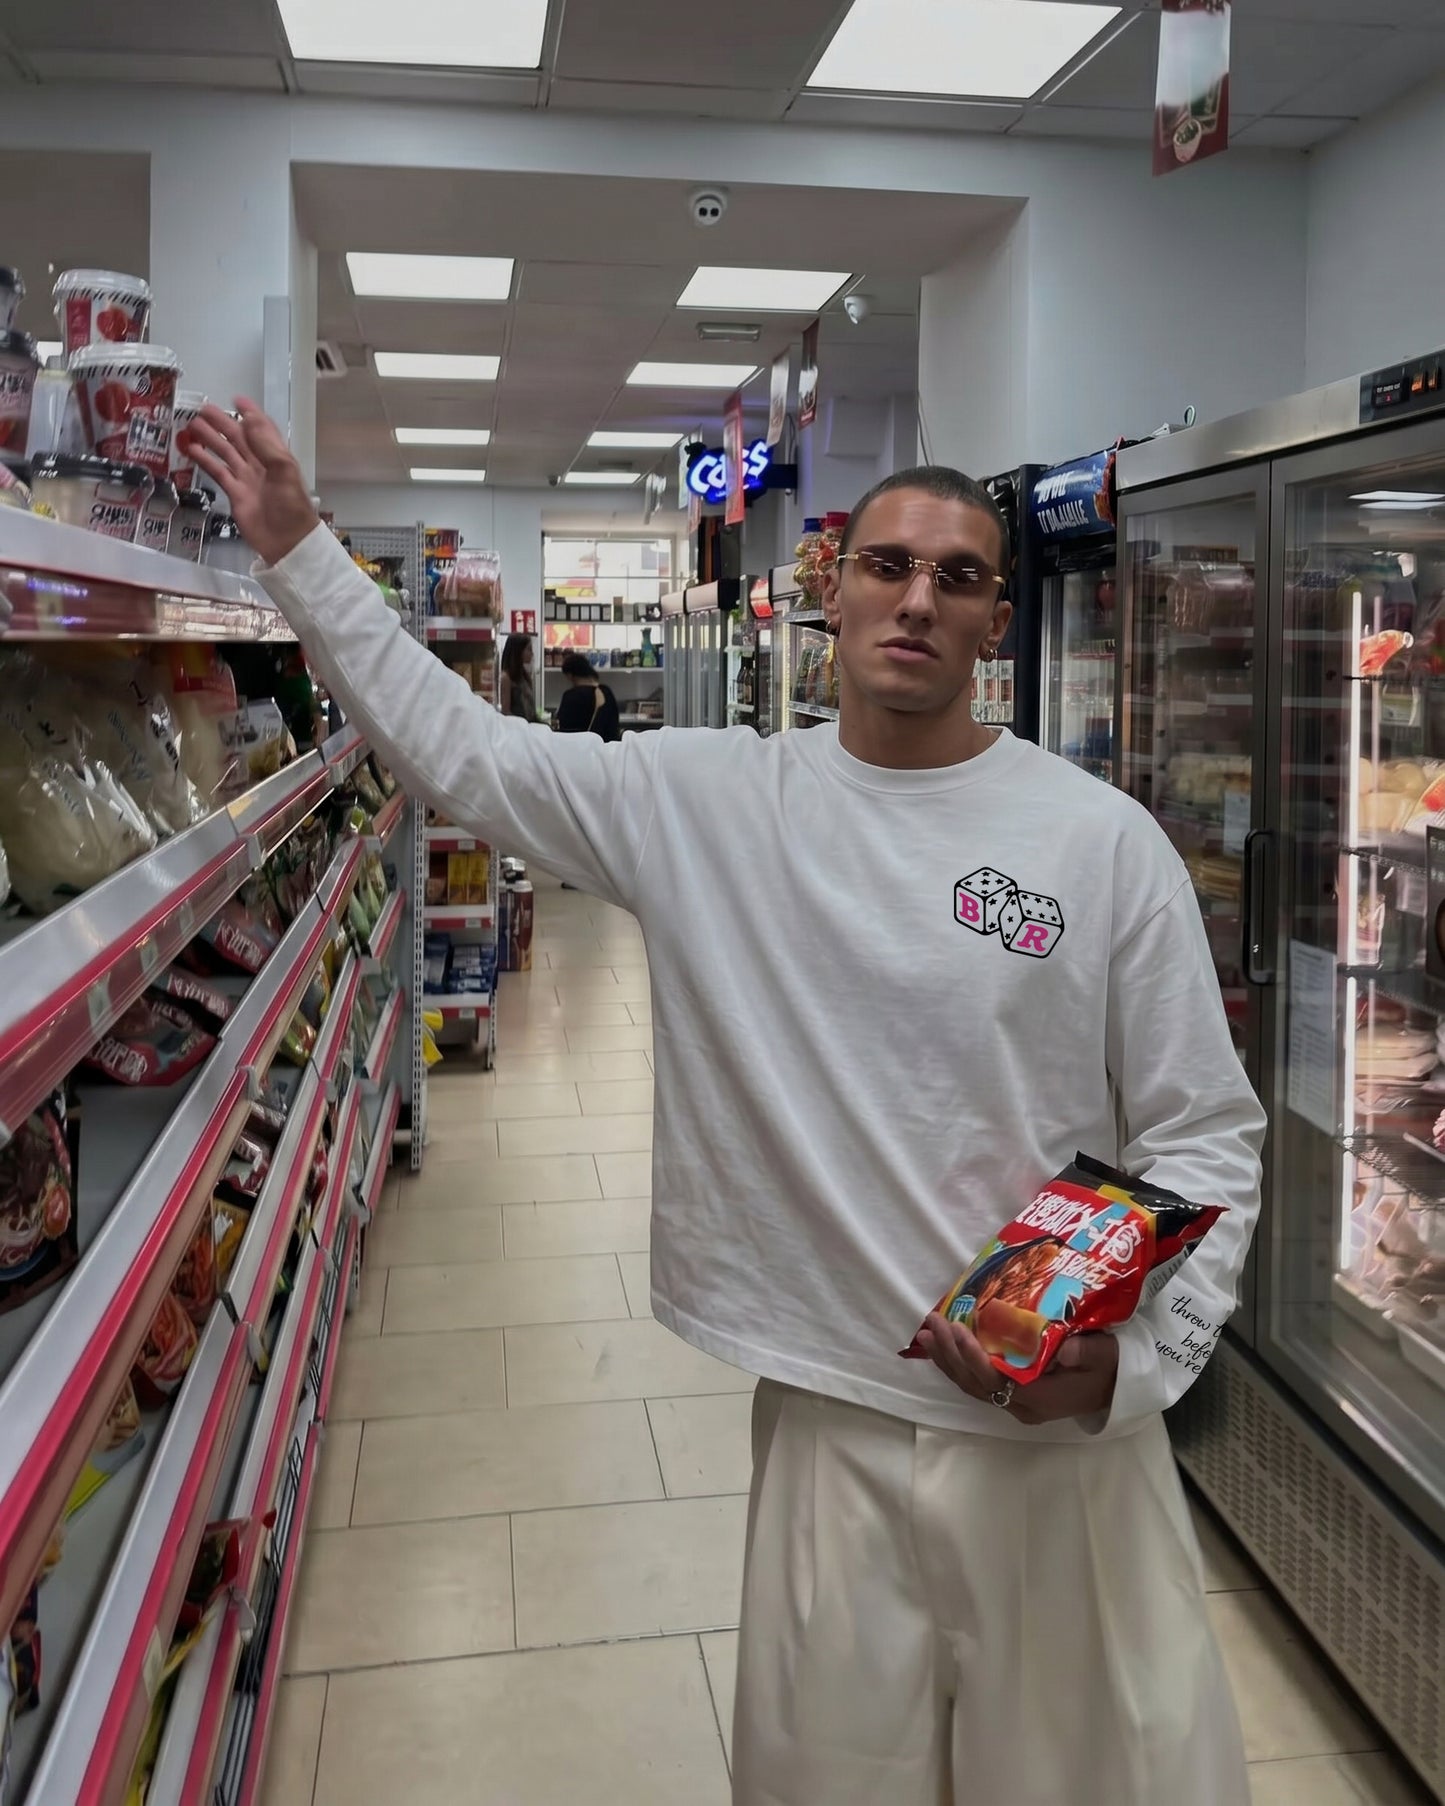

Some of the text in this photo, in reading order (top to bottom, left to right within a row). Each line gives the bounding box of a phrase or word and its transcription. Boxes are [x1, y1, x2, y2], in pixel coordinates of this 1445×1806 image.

[958, 892, 980, 923] B
[1016, 923, 1048, 952] R
[1170, 1296, 1226, 1338] throw t
[1154, 1340, 1202, 1374] you're
[1180, 1330, 1212, 1361] befo
